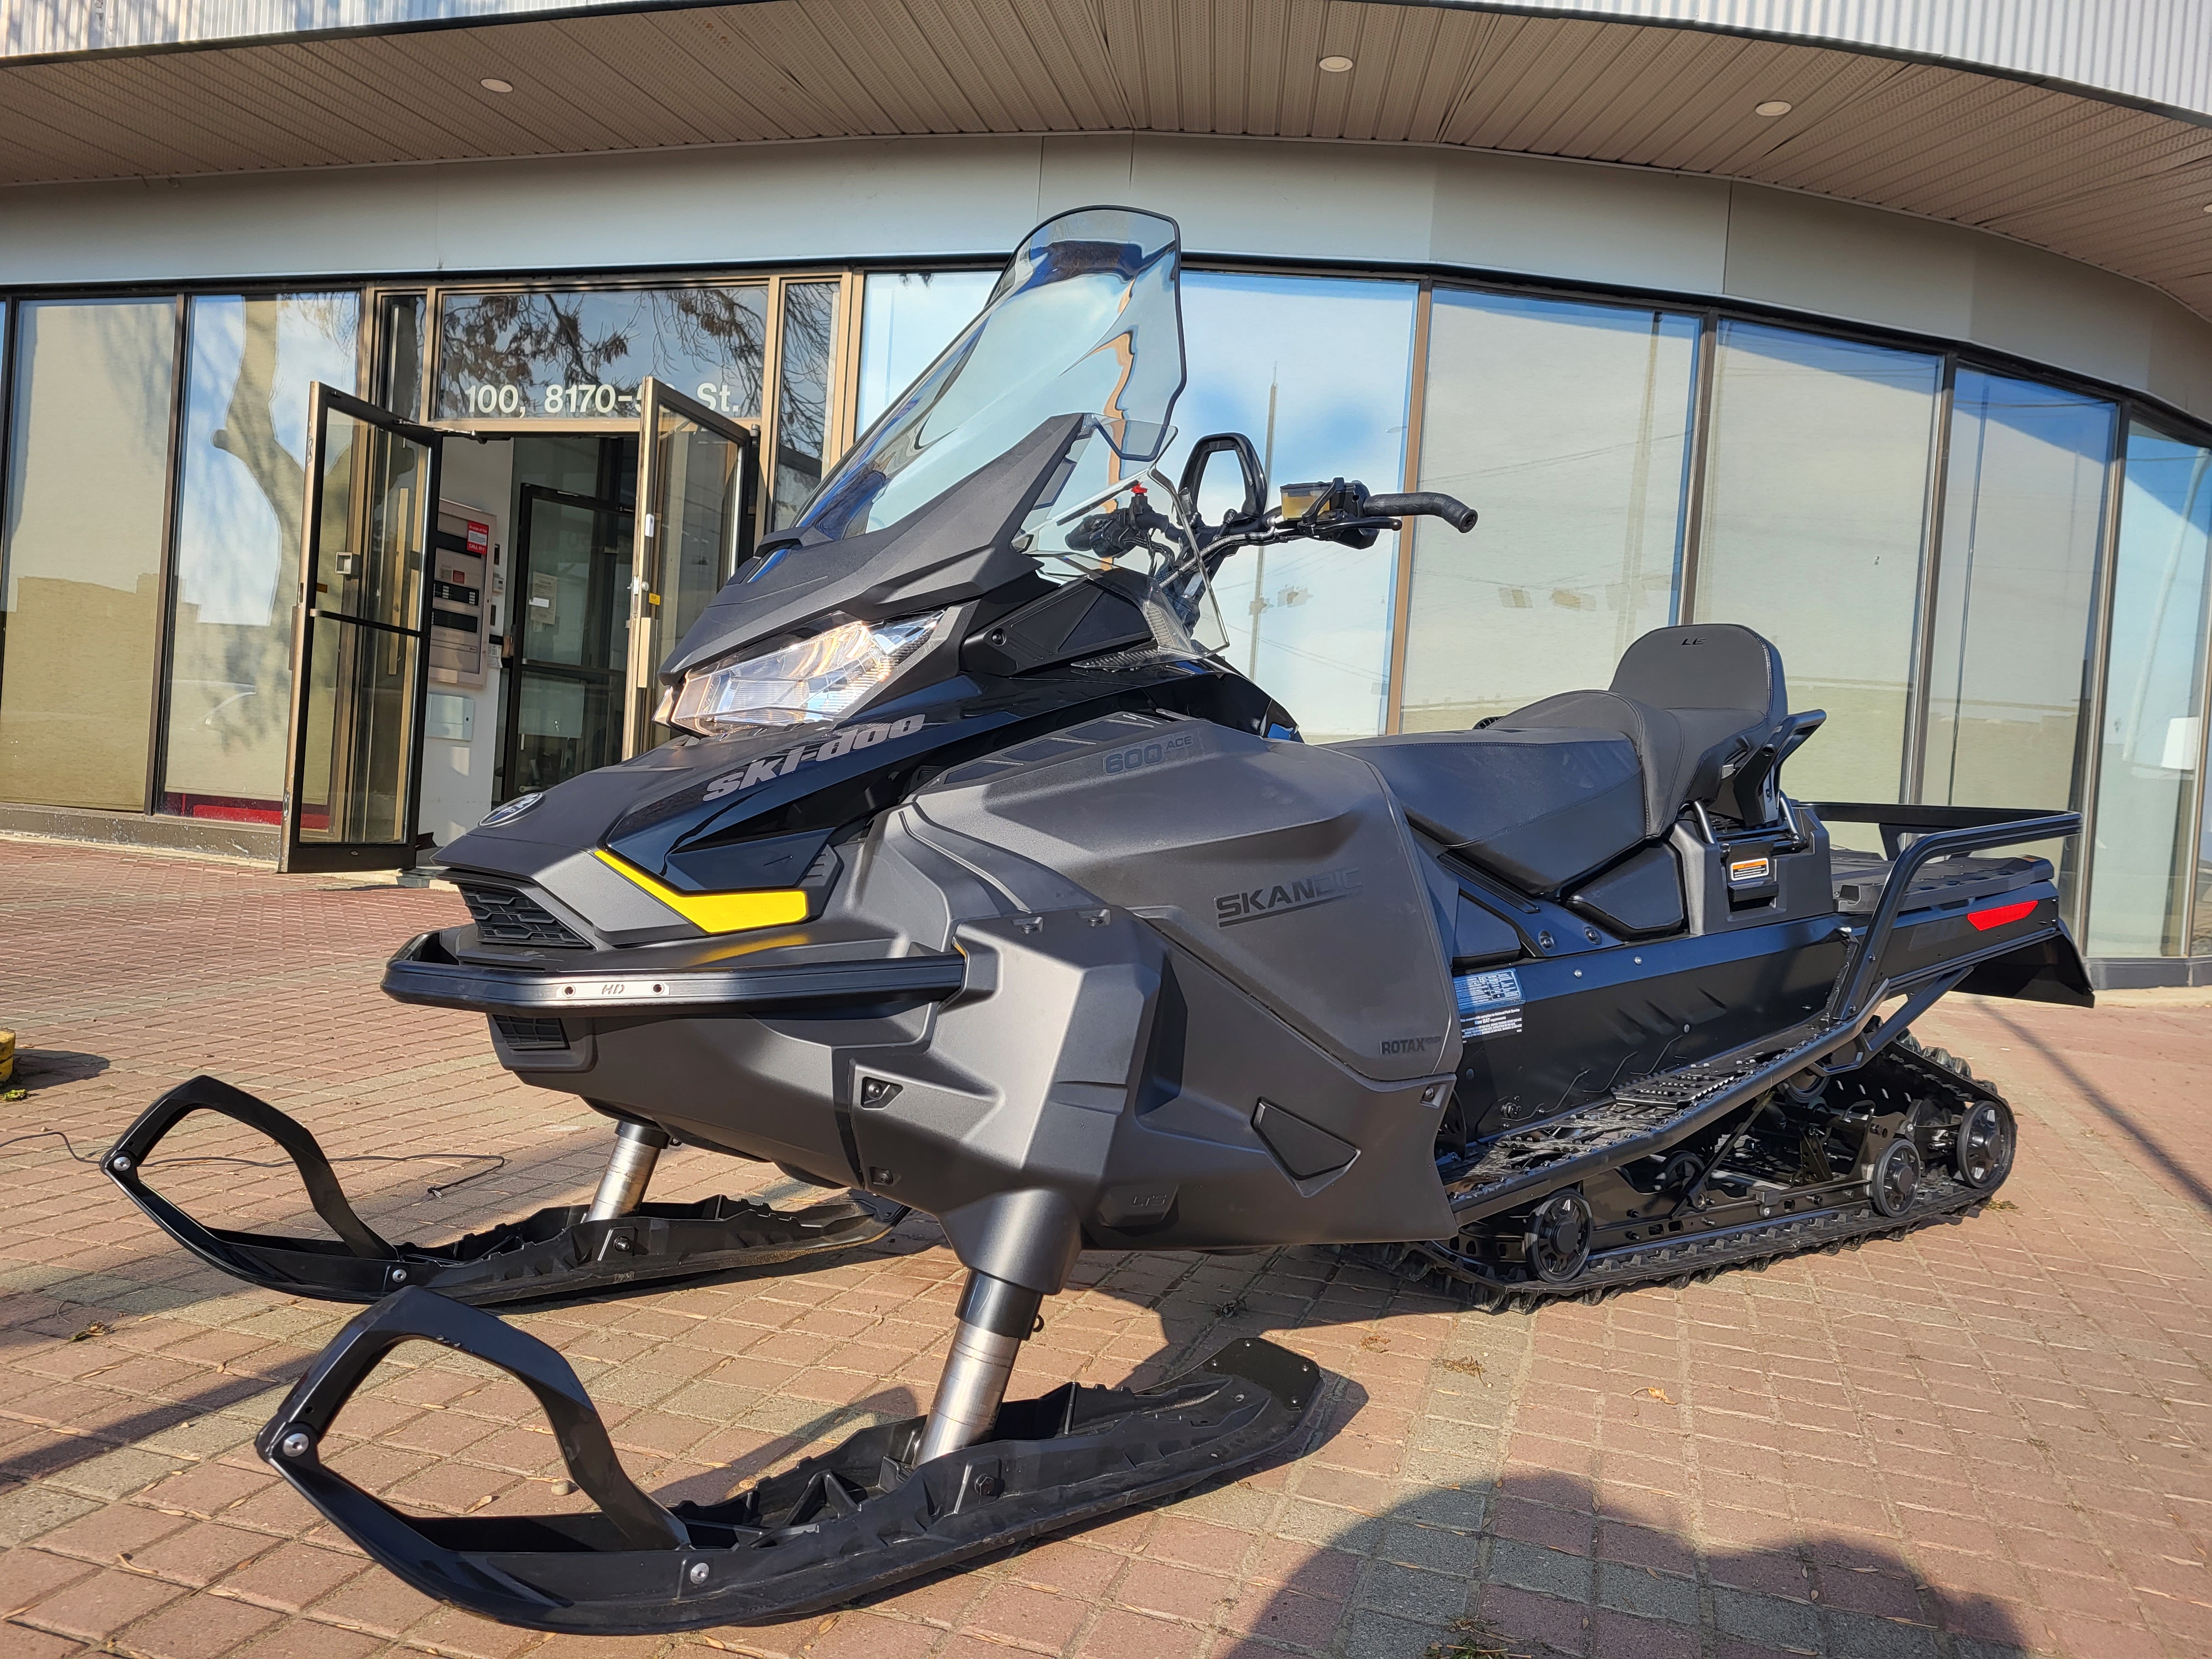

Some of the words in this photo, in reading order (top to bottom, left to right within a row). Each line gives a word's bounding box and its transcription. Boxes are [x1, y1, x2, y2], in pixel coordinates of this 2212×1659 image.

[467, 384, 526, 418] 100,
[544, 384, 676, 414] 8170-
[696, 382, 739, 413] St.
[1106, 744, 1162, 774] 600
[1165, 735, 1192, 750] ACE
[601, 984, 625, 994] HD
[1381, 1036, 1425, 1055] ROTAX
